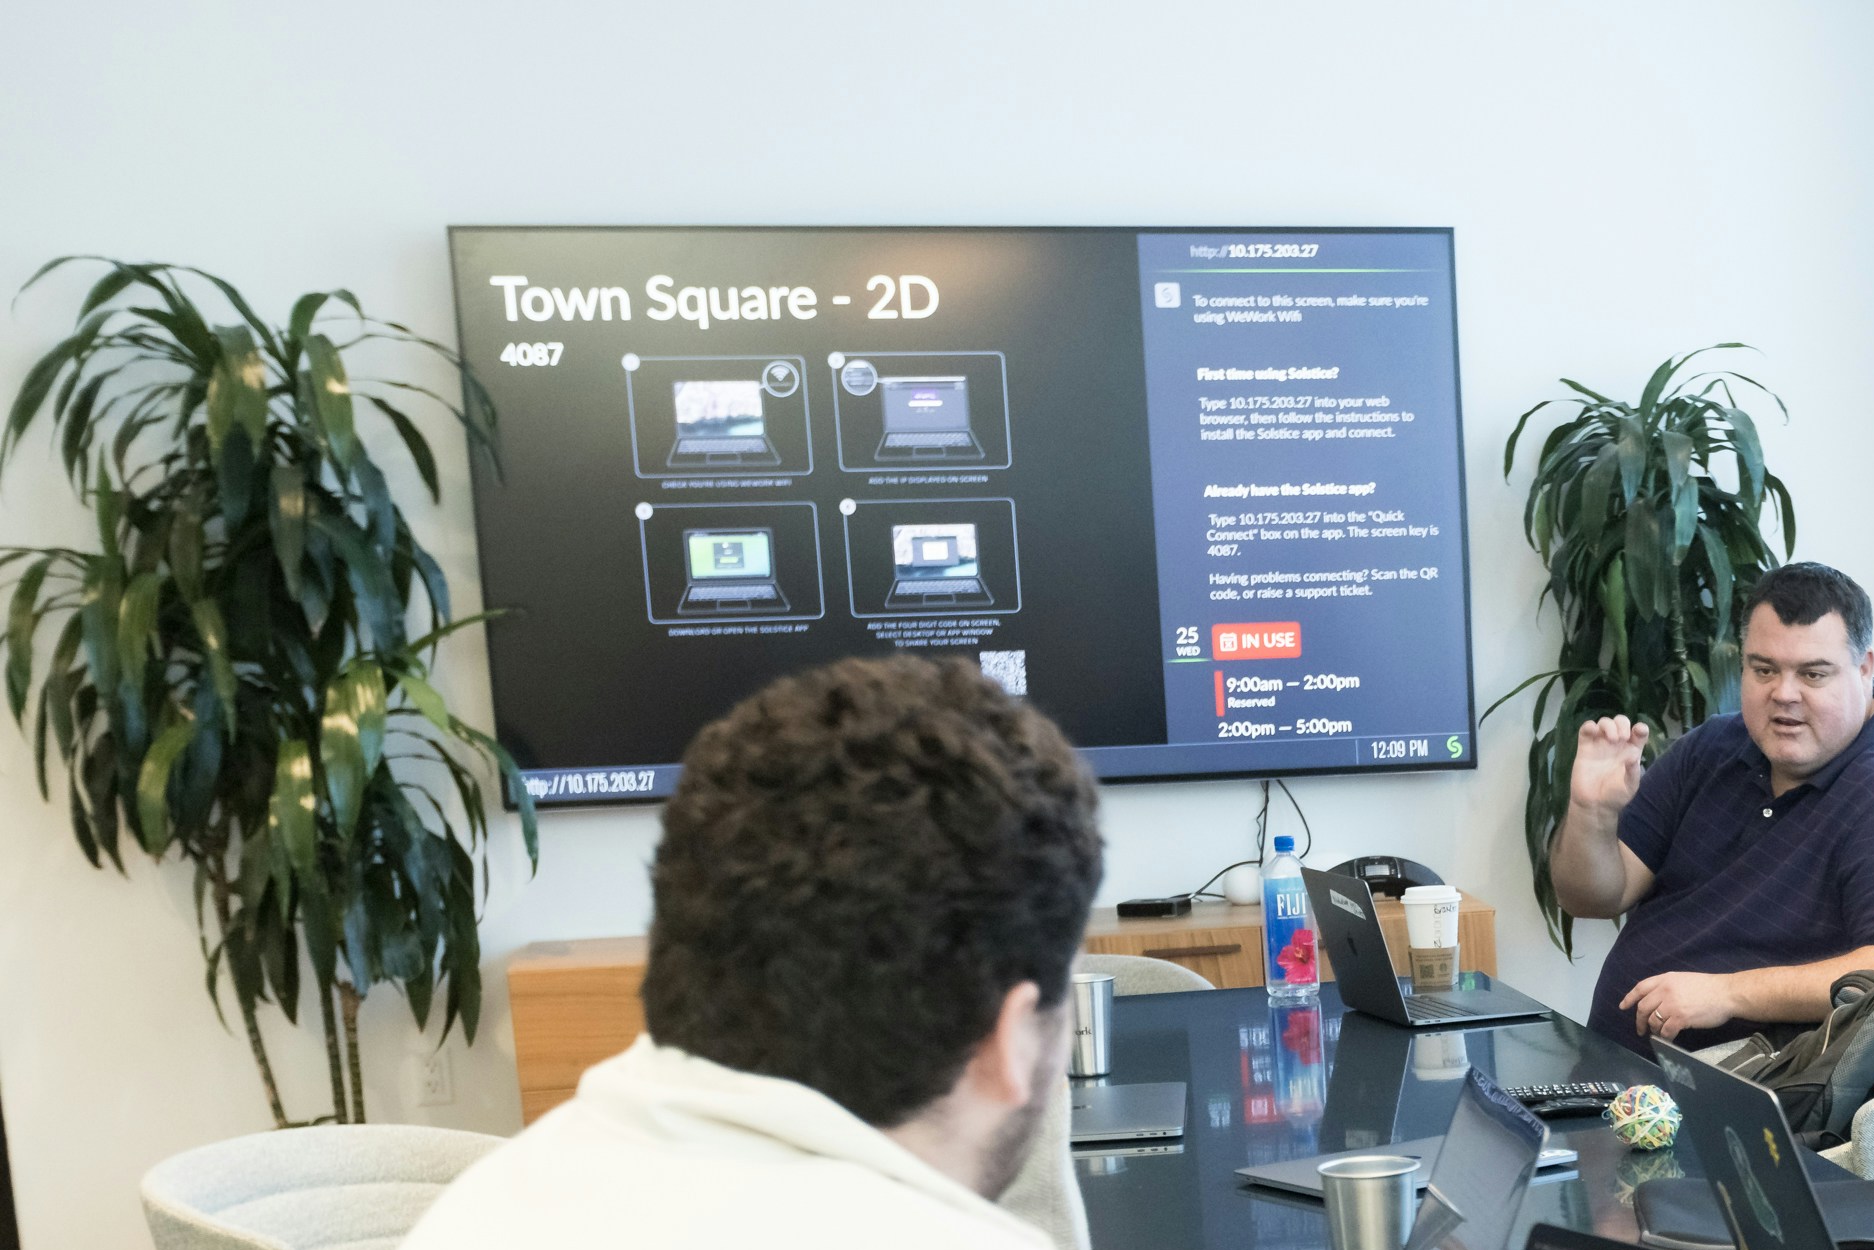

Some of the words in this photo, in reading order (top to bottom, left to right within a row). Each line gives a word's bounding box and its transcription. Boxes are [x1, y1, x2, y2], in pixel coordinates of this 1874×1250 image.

[490, 275, 632, 321] Town
[645, 275, 817, 329] Square
[866, 275, 939, 320] 2D
[1193, 295, 1208, 308] To
[1209, 295, 1255, 308] connect
[1257, 295, 1270, 307] to
[1272, 295, 1294, 306] this
[1295, 296, 1335, 308] screen,
[1336, 295, 1366, 306] make
[1367, 296, 1393, 306] sure
[1395, 295, 1429, 308] you're
[499, 341, 563, 367] 4087
[1197, 368, 1225, 381] First
[1226, 368, 1254, 380] time
[1255, 368, 1287, 381] using
[1288, 367, 1339, 380] Solstice?
[1199, 397, 1226, 411] Type
[1229, 396, 1312, 409] 10.175.203.27
[1314, 397, 1336, 408] into
[1338, 397, 1365, 410] your
[1366, 396, 1390, 408] web
[1200, 413, 1248, 426] browser,
[1250, 412, 1276, 425] then
[1278, 411, 1313, 424] follow
[1315, 411, 1333, 423] the
[1335, 411, 1399, 423] instructions
[1401, 411, 1414, 422] to
[1201, 428, 1233, 441] install
[1236, 428, 1255, 440] the
[1257, 427, 1300, 440] Solstice
[1301, 429, 1323, 441] app
[1325, 427, 1346, 439] and
[1348, 427, 1396, 439] connect.
[1204, 485, 1249, 499] Already
[1250, 485, 1279, 497] have
[1280, 484, 1300, 496] the
[1302, 483, 1347, 496] Solstice
[1349, 482, 1376, 496] app?
[1208, 514, 1236, 527] Type
[1239, 512, 1321, 525] 10.175.203.27
[1323, 512, 1345, 523] into
[1347, 512, 1366, 523] the
[1260, 528, 1281, 540] box
[1283, 530, 1298, 540] on
[1300, 528, 1319, 539] the
[1321, 529, 1345, 540] app.
[1347, 526, 1369, 538] The
[1371, 528, 1407, 537] screen
[1409, 525, 1427, 538] key
[1429, 525, 1439, 536] is
[1207, 544, 1241, 557] 4087.
[1209, 572, 1249, 586] Having
[1250, 571, 1301, 584] problems
[1303, 570, 1368, 583] connecting?
[1371, 568, 1397, 580] Scan
[1399, 568, 1417, 579] the
[1419, 567, 1438, 580] QR
[1210, 587, 1241, 600] code,
[1242, 589, 1255, 599] or
[1257, 587, 1283, 599] raise
[1285, 588, 1293, 597] a
[1295, 585, 1338, 599] support
[1339, 585, 1372, 596] ticket.
[1176, 627, 1199, 645] 25
[1241, 633, 1260, 649] IN
[1263, 632, 1295, 648] USE
[1176, 646, 1200, 657] WED
[1226, 676, 1283, 692] 9:00am
[1303, 674, 1360, 692] 2:00pm
[1227, 696, 1275, 708] Reserved
[1218, 721, 1275, 739] 2:00pm
[1296, 718, 1352, 736] 5:00pm
[1371, 741, 1406, 759] 12:09
[1409, 739, 1428, 757] PM
[1277, 892, 1306, 917] FIJI
[1075, 1027, 1092, 1036] ork
